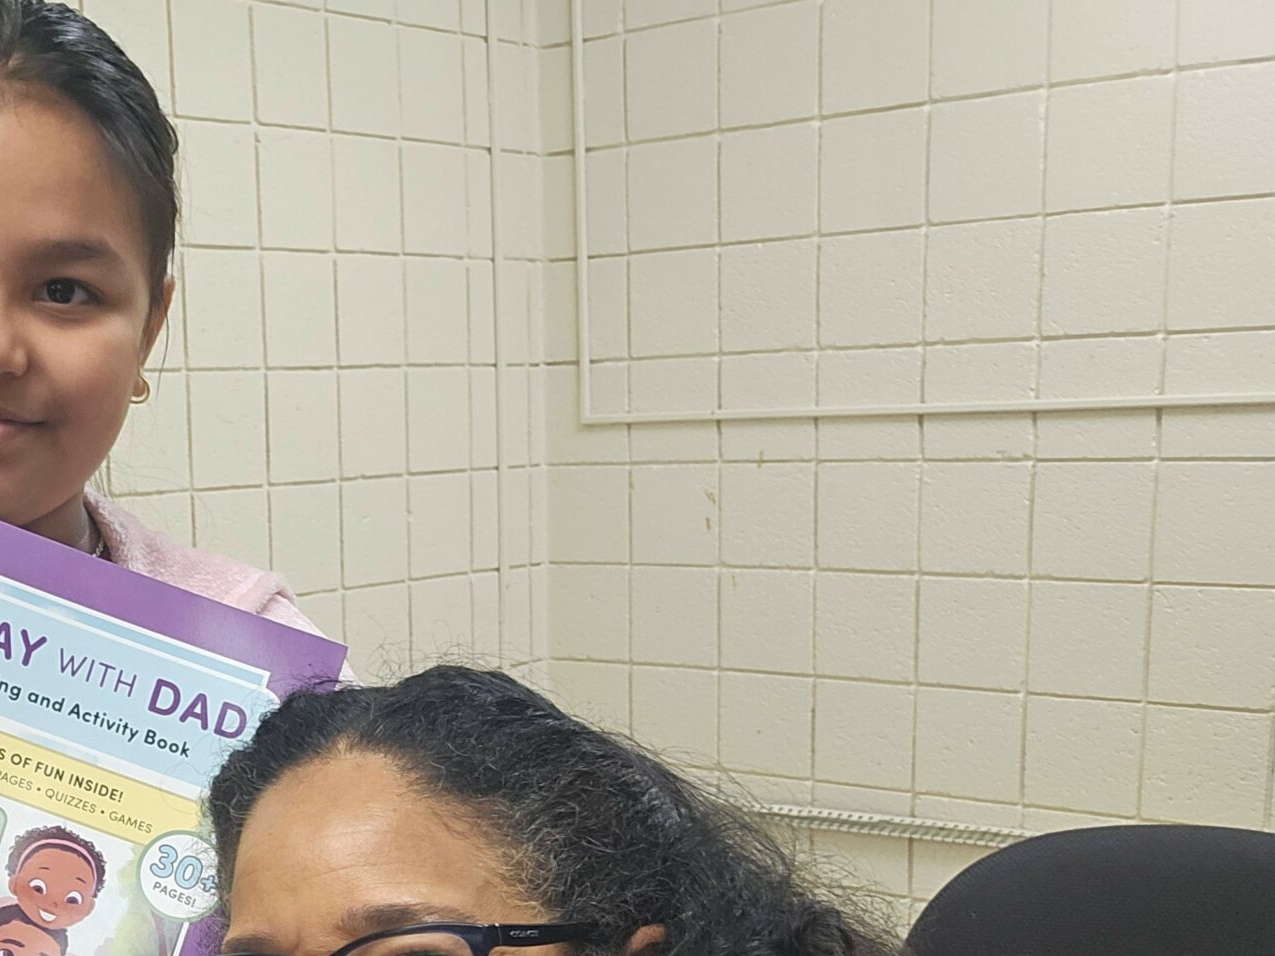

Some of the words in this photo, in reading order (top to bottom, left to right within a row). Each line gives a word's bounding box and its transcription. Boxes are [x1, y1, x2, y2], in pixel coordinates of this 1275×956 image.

[60, 648, 137, 697] WITH
[147, 678, 247, 739] DAD
[27, 692, 65, 713] and
[68, 703, 139, 743] Activity
[144, 729, 190, 758] Book
[10, 753, 32, 768] OF
[34, 762, 65, 782] FUN
[68, 773, 124, 803] INSIDE!
[45, 788, 96, 814] QUIZZES
[109, 811, 153, 834] GAMES
[150, 844, 218, 890] 30+
[152, 881, 197, 908] PAGES!
